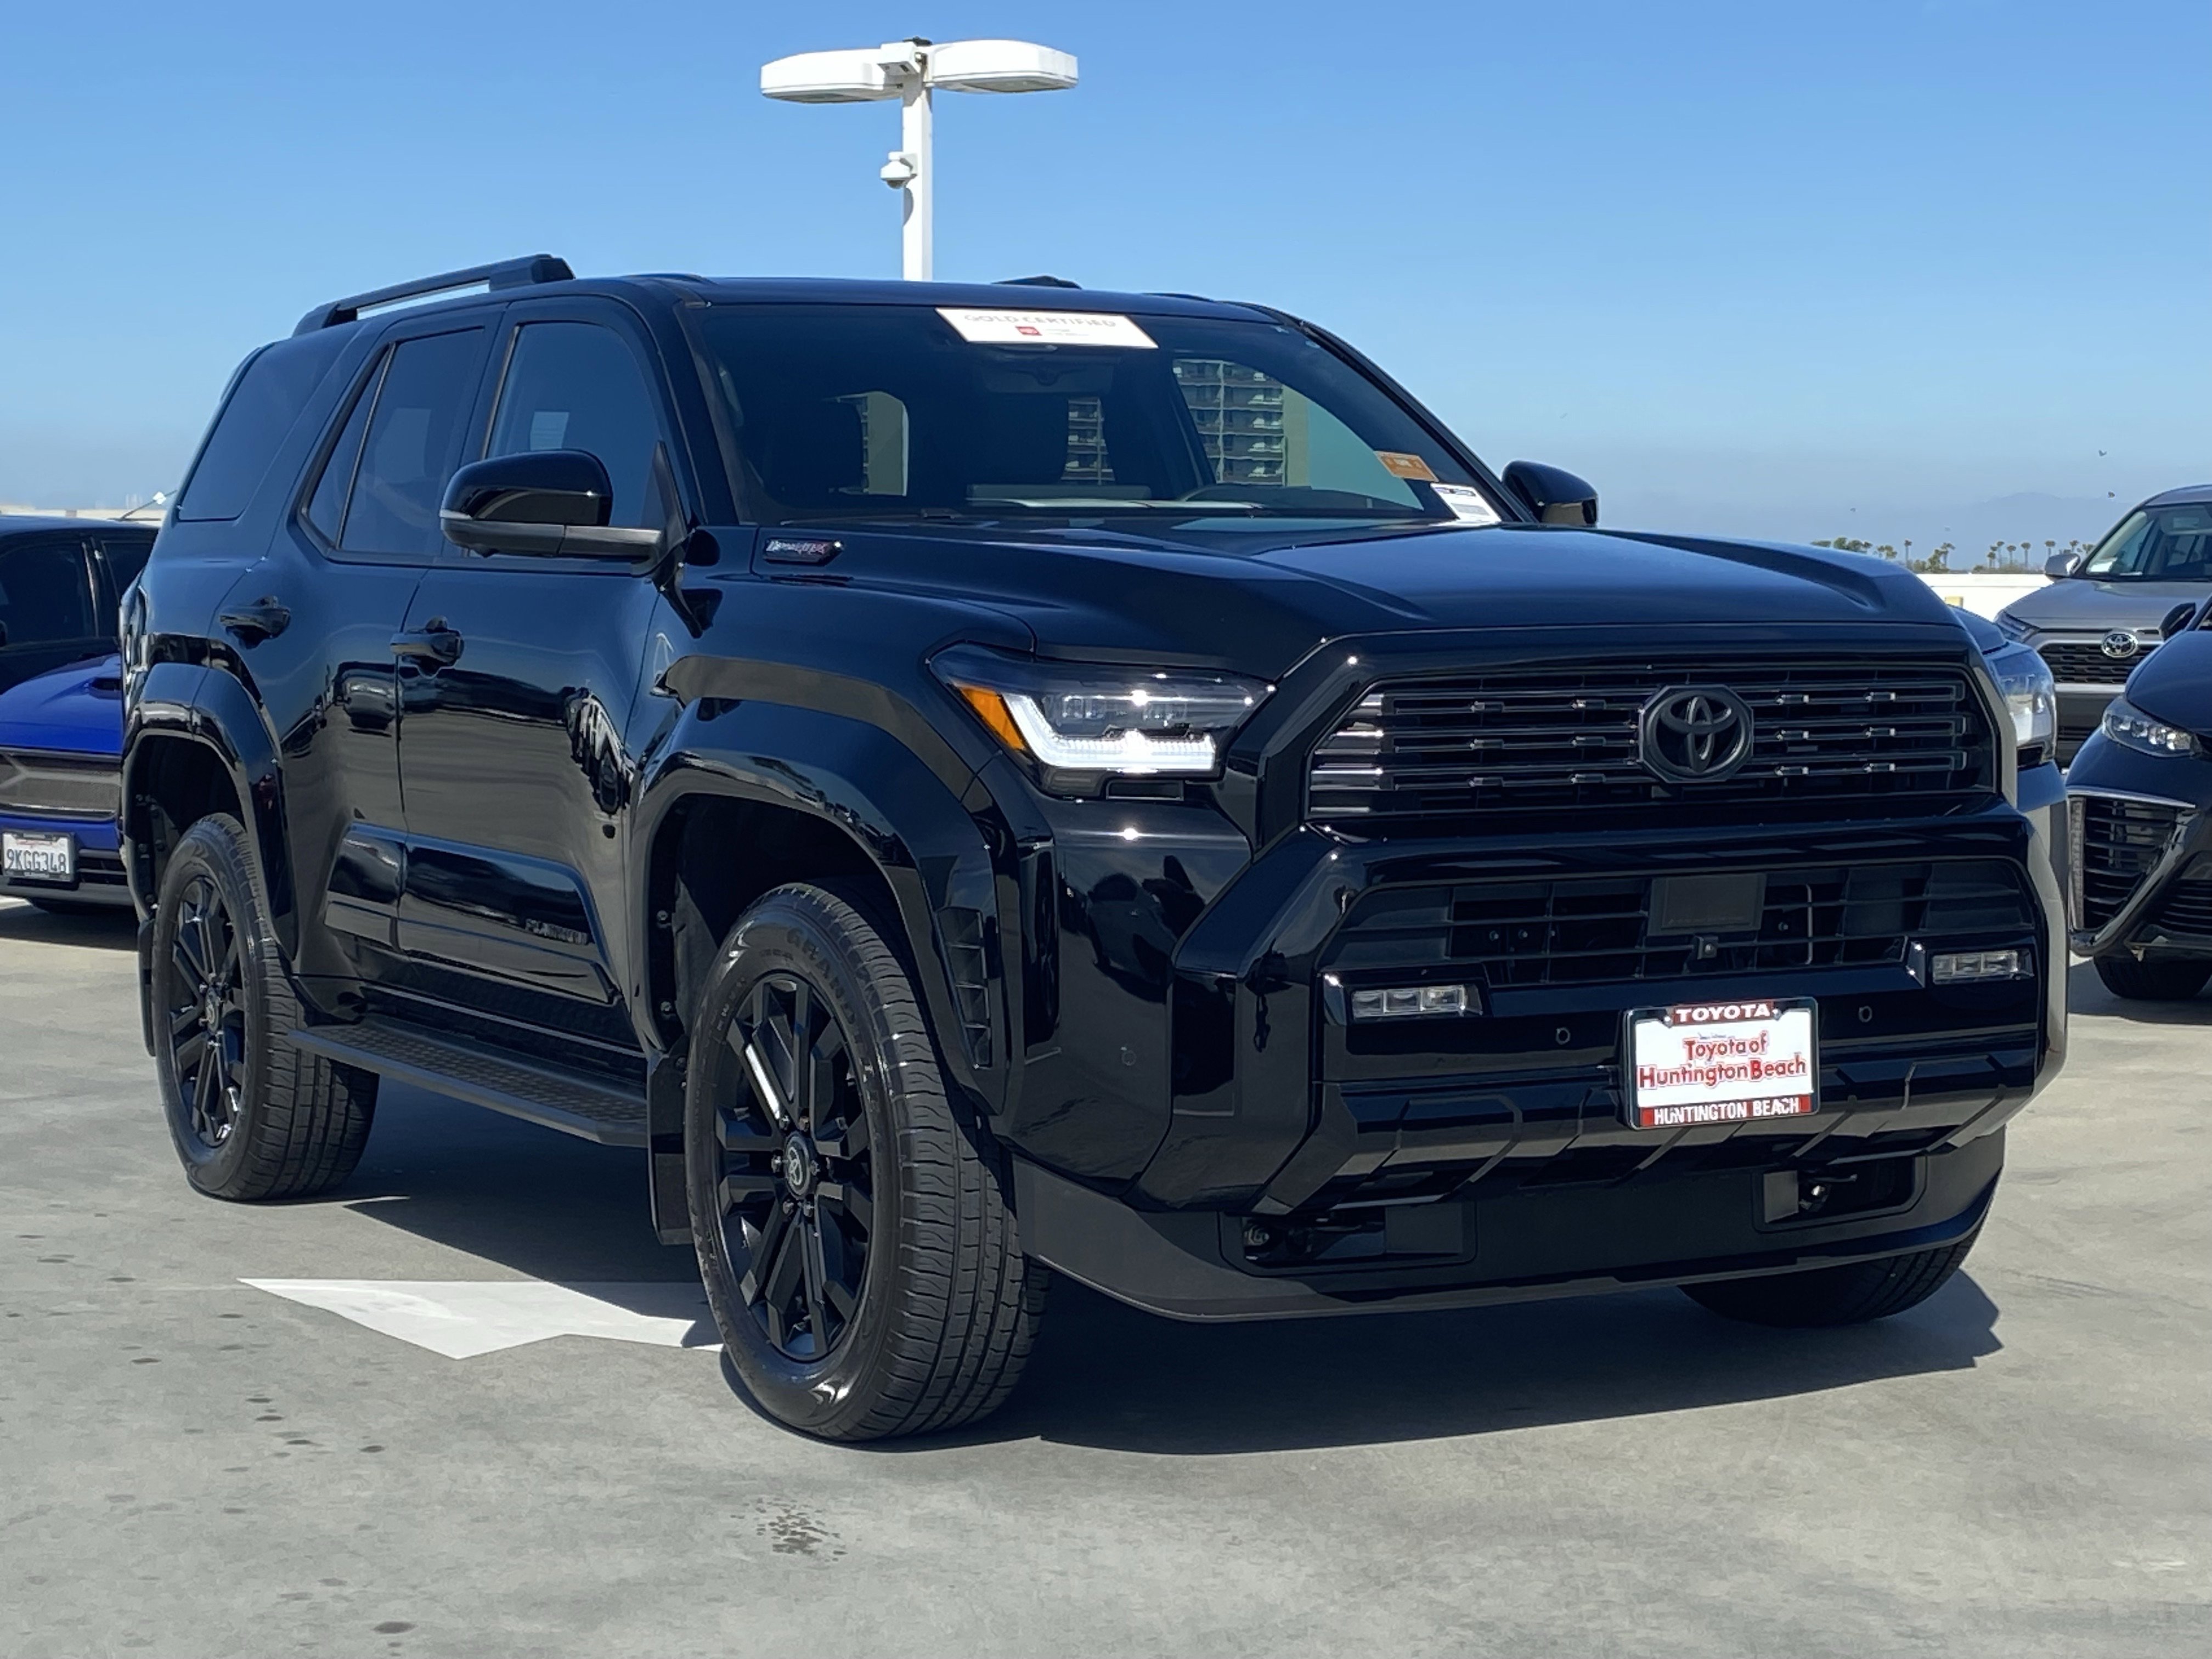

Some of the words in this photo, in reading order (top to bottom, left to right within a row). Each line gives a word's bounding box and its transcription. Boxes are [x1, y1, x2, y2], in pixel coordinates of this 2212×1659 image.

[964, 314, 1019, 323] GOLD
[1022, 316, 1116, 328] CERTIFIED
[1675, 1003, 1771, 1023] TOYOTA
[1684, 1039, 1746, 1062] Toyota
[1749, 1032, 1767, 1053] of
[1639, 1062, 1748, 1088] Huntington
[1750, 1054, 1805, 1080] Beach
[1654, 1101, 1747, 1125] HUNTINGTON
[1752, 1097, 1799, 1116] BEACH
